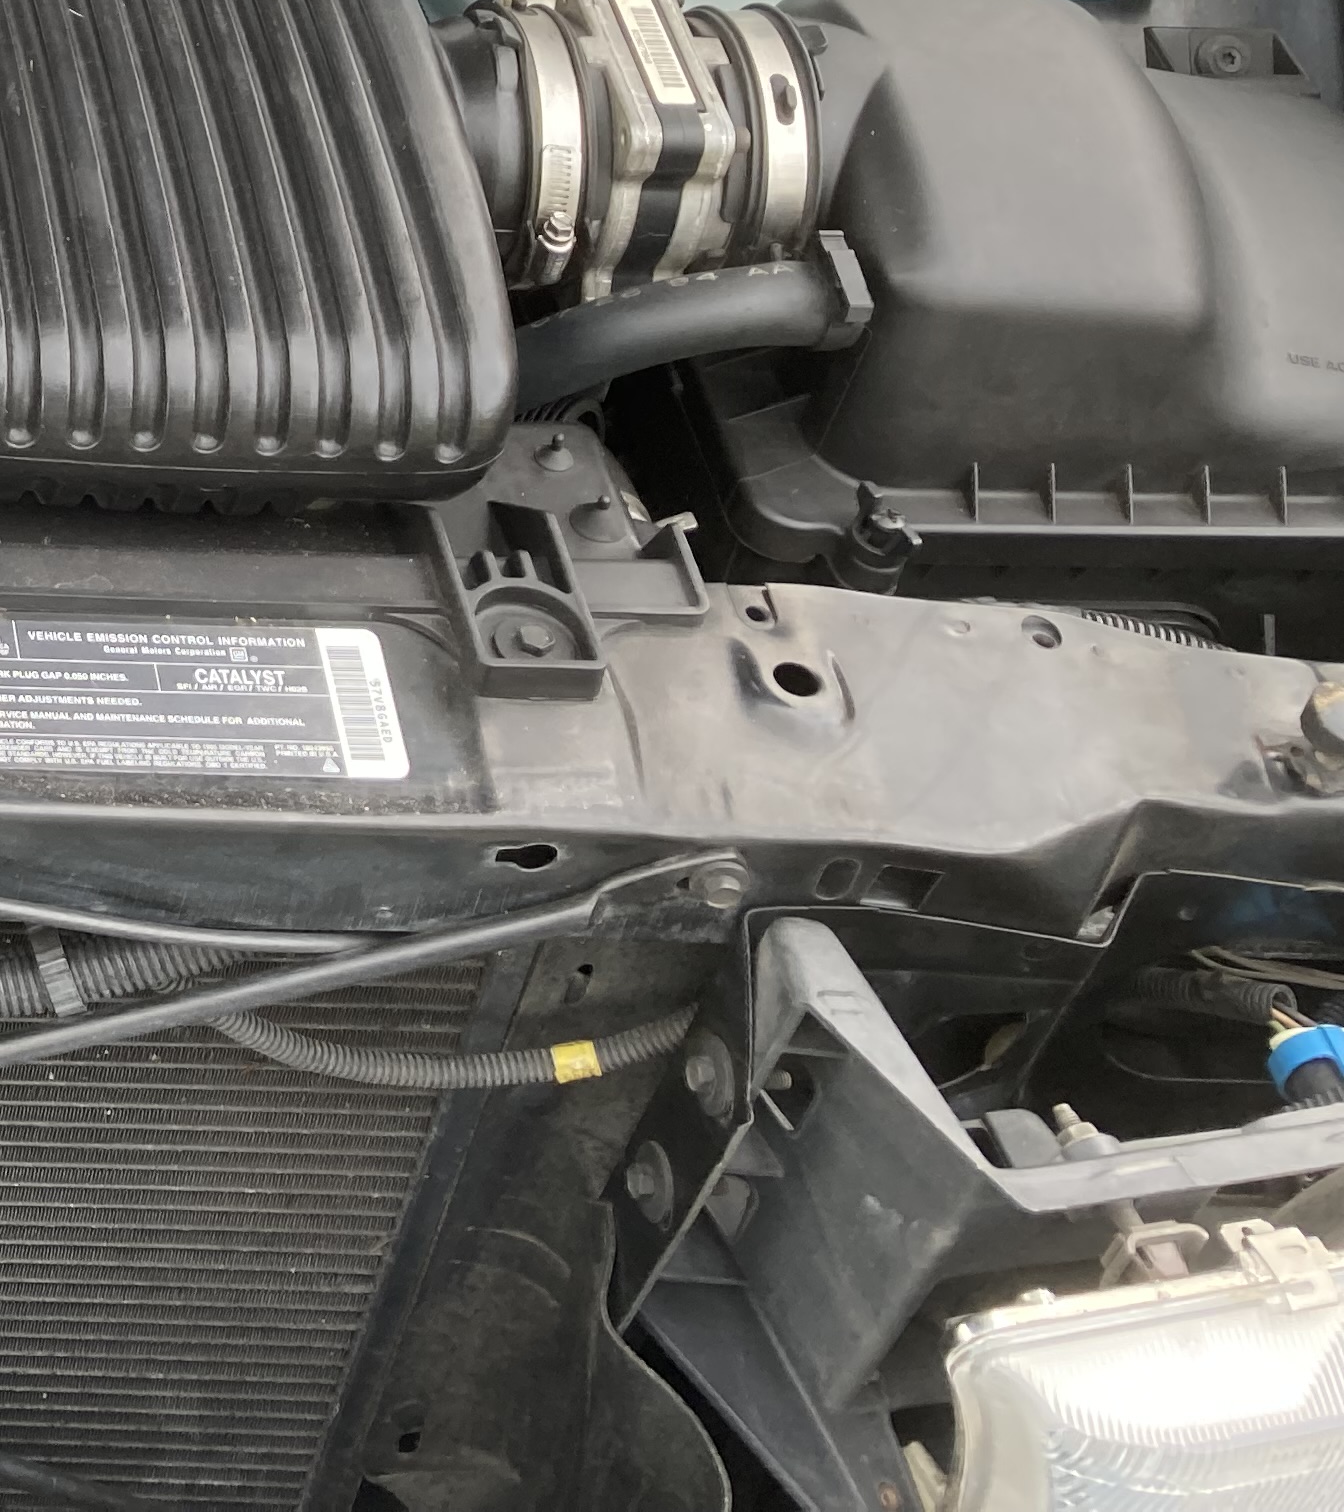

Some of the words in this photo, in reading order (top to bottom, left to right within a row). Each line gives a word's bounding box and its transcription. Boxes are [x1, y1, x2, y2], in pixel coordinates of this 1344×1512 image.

[1287, 352, 1320, 368] USE
[27, 631, 82, 642] VEHICLE
[86, 633, 148, 644] EMISSION
[152, 634, 214, 646] CONTROL
[217, 636, 306, 648] INFORMATION
[103, 645, 138, 654] General
[141, 646, 171, 655] Motors
[174, 646, 227, 656] Corporation
[13, 670, 39, 679] PLUG
[41, 670, 62, 680] GAP
[90, 672, 129, 682] INCHES.
[194, 668, 286, 685] CATALYST
[17, 695, 95, 705] ADJUSTMENTS
[96, 697, 143, 707] NEEDED.
[30, 711, 72, 720] MANUAL
[73, 712, 95, 722] AND
[95, 713, 166, 723] MAINTENANCE
[167, 715, 221, 725] SCHEDULE
[222, 716, 243, 725] FOR
[246, 717, 306, 727] ADDITIONAL
